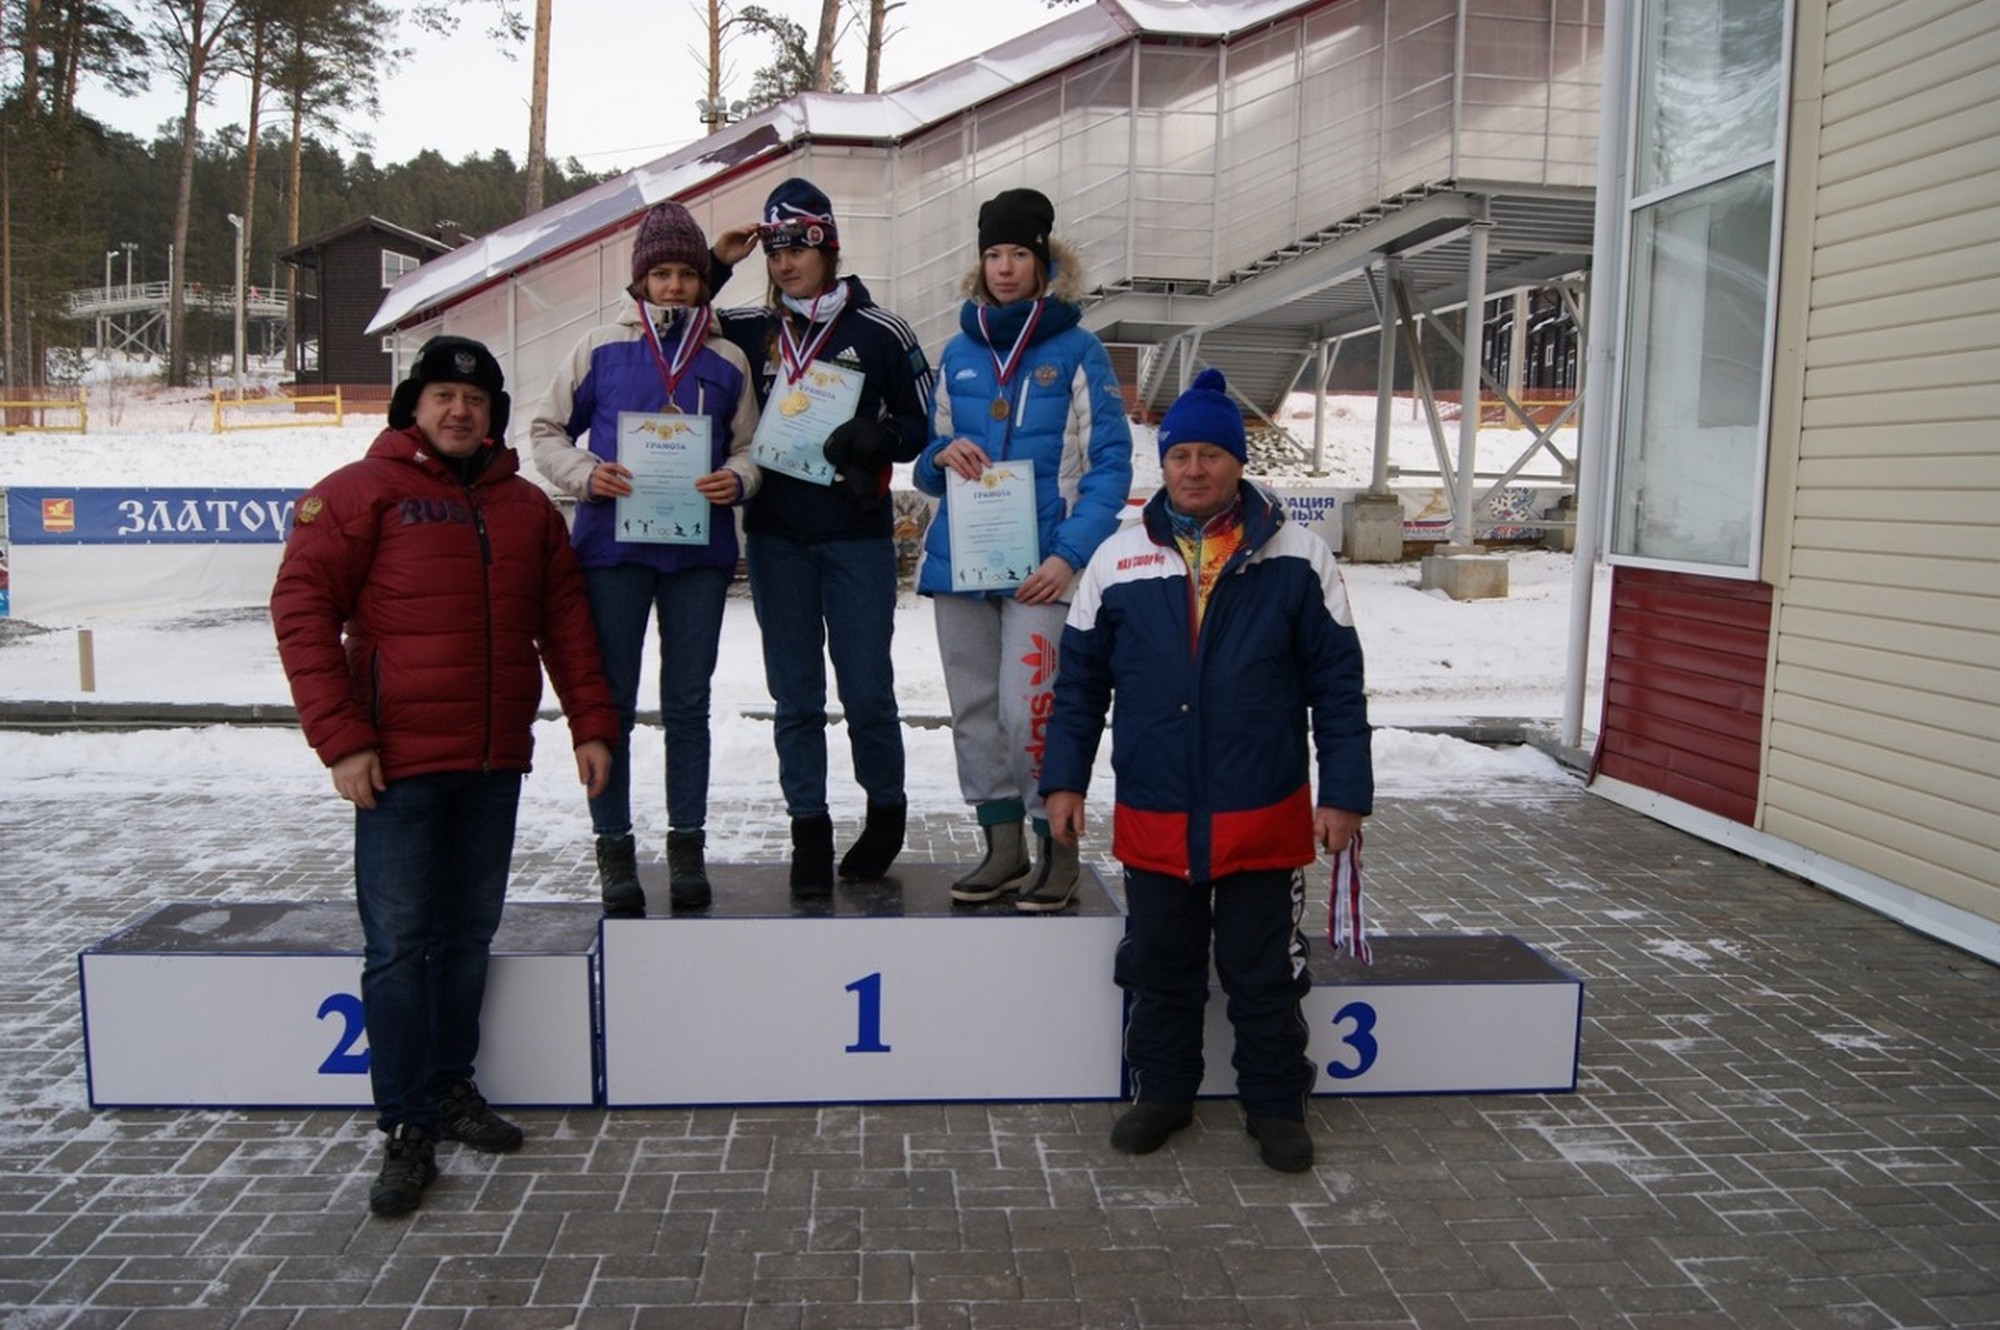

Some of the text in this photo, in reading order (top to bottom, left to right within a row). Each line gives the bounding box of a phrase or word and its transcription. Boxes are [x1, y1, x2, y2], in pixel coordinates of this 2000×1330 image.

[645, 441, 687, 450] ГРАМОТА
[1284, 496, 1335, 510] АЦИЯ
[317, 993, 370, 1075] 2
[845, 972, 892, 1053] 1
[1326, 1001, 1378, 1080] 3
